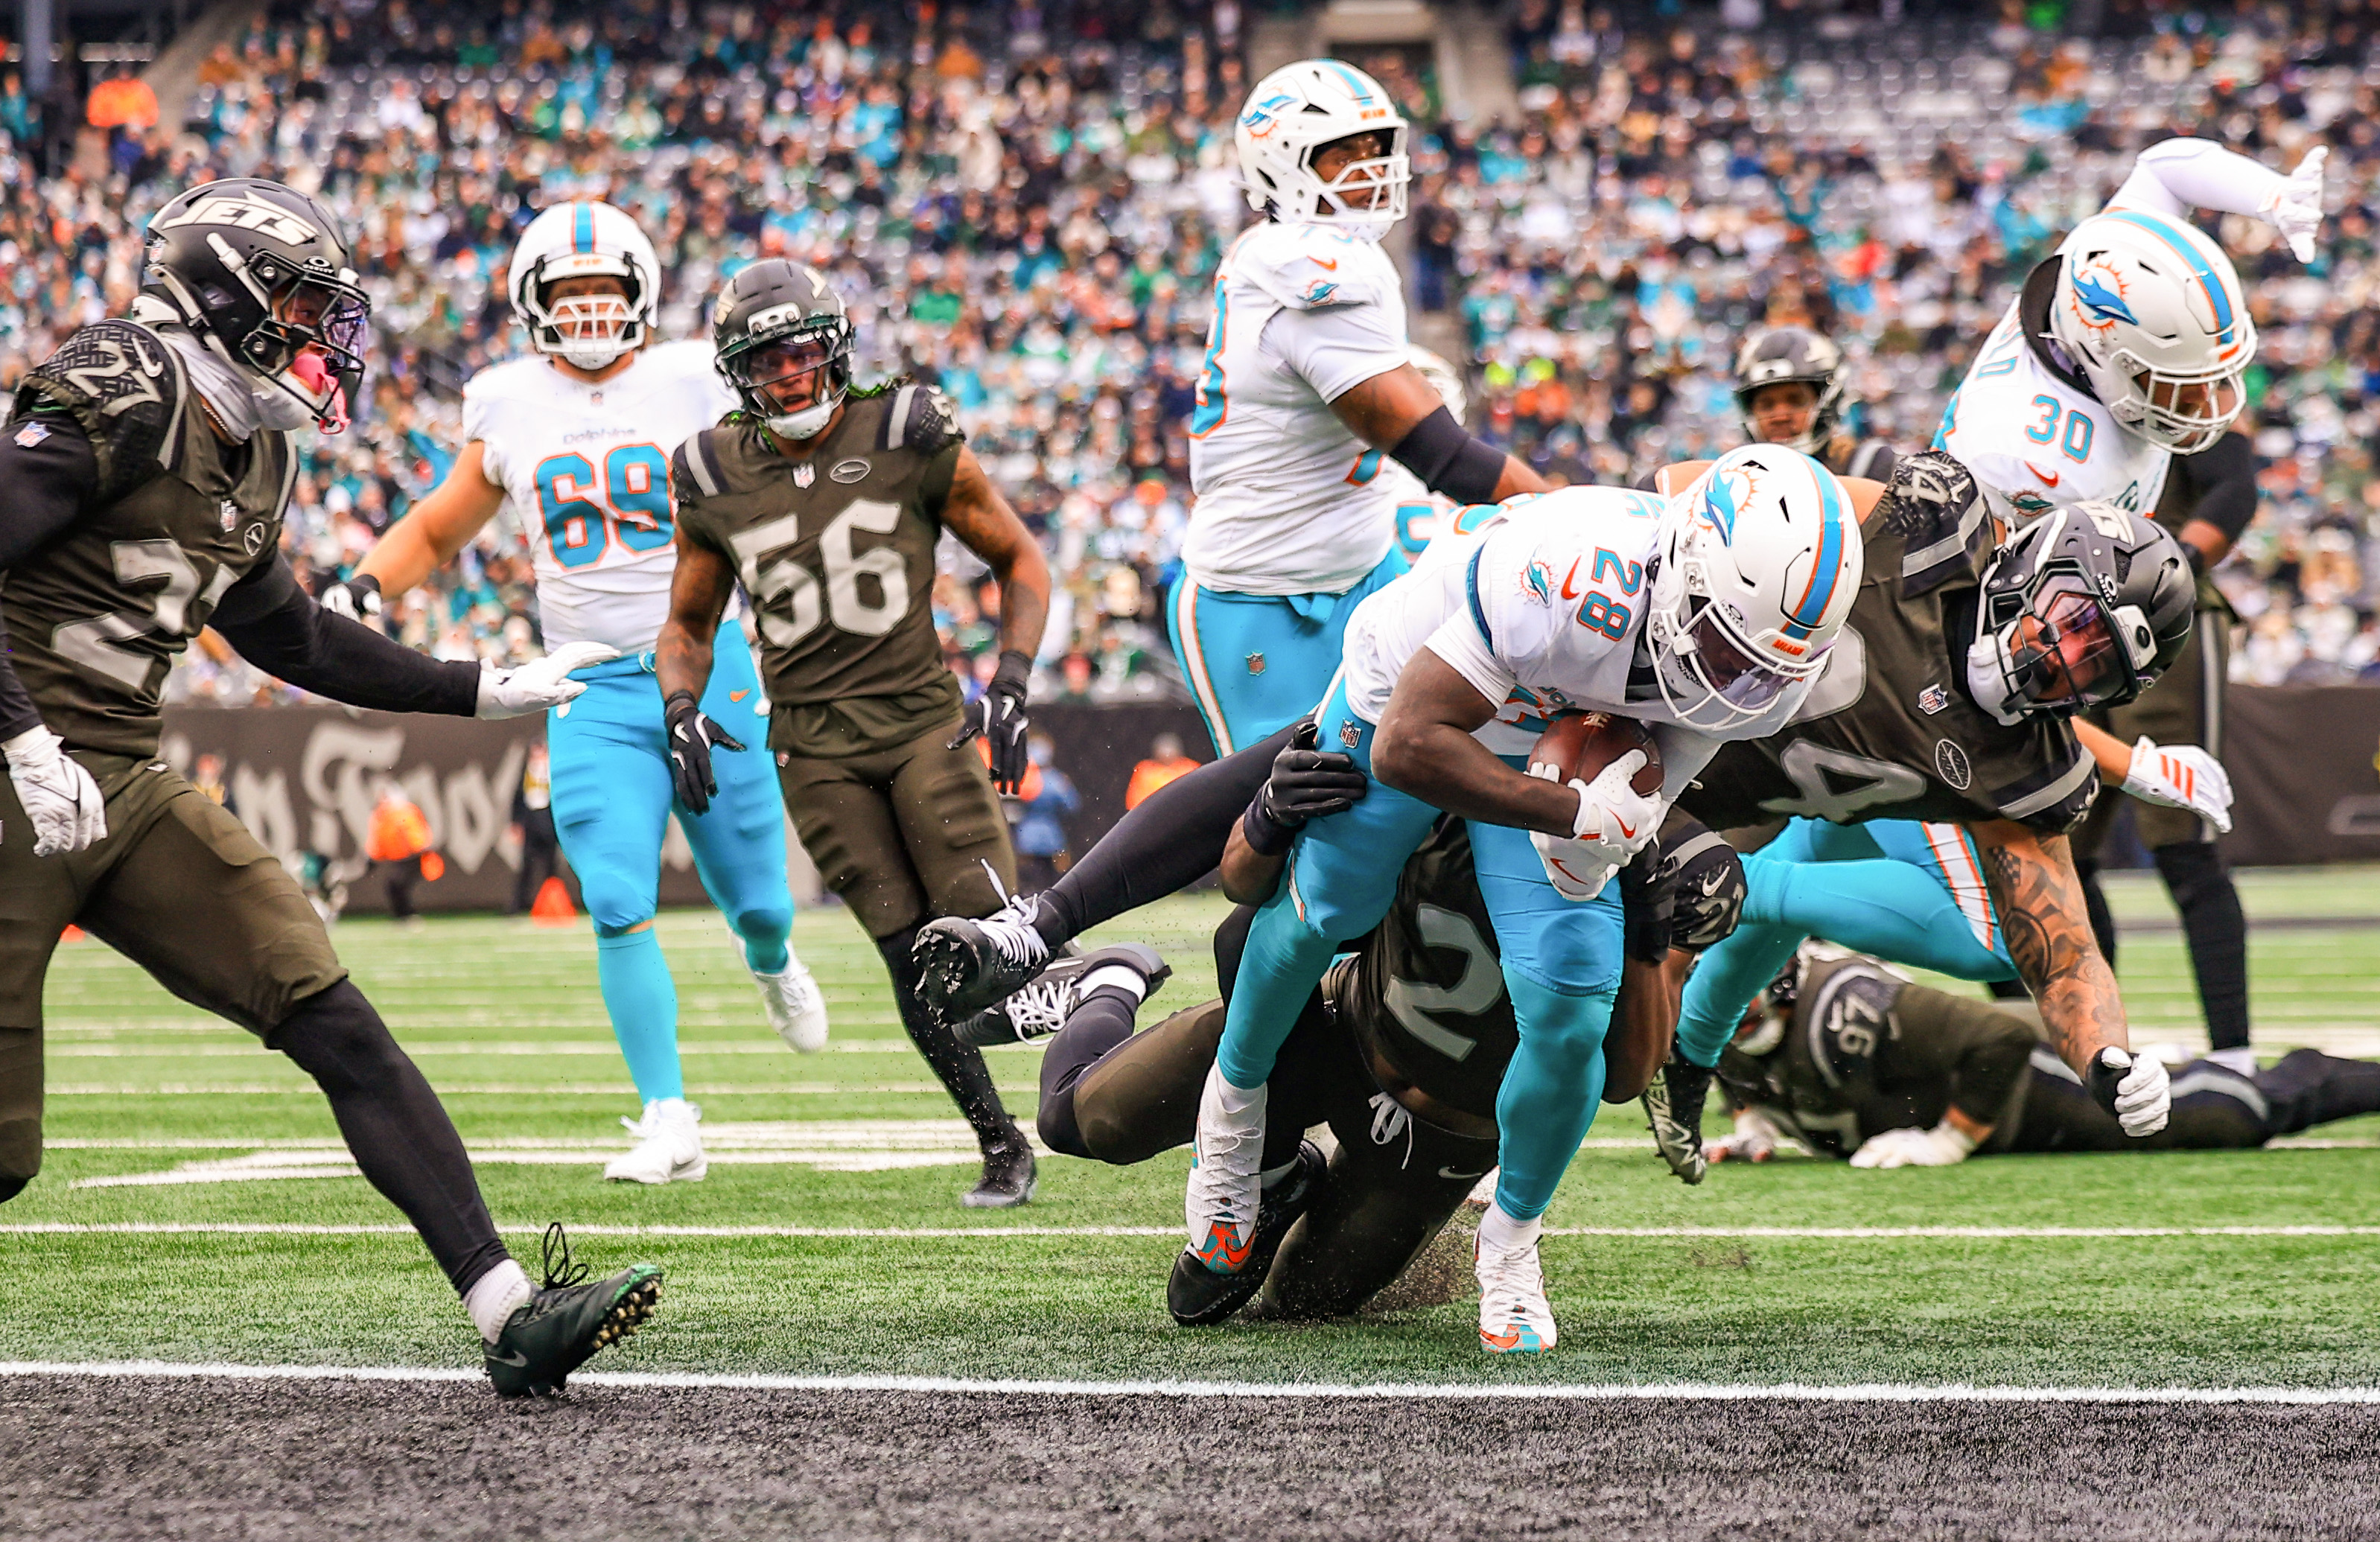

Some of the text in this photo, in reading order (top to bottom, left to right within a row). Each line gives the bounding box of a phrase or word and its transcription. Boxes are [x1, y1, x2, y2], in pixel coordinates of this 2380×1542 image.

[162, 191, 320, 246] JETS
[2024, 393, 2094, 465] 30
[534, 442, 677, 571] 69
[728, 498, 909, 649] 56
[1576, 546, 1643, 642] 28
[1772, 638, 1807, 657] MIAMI
